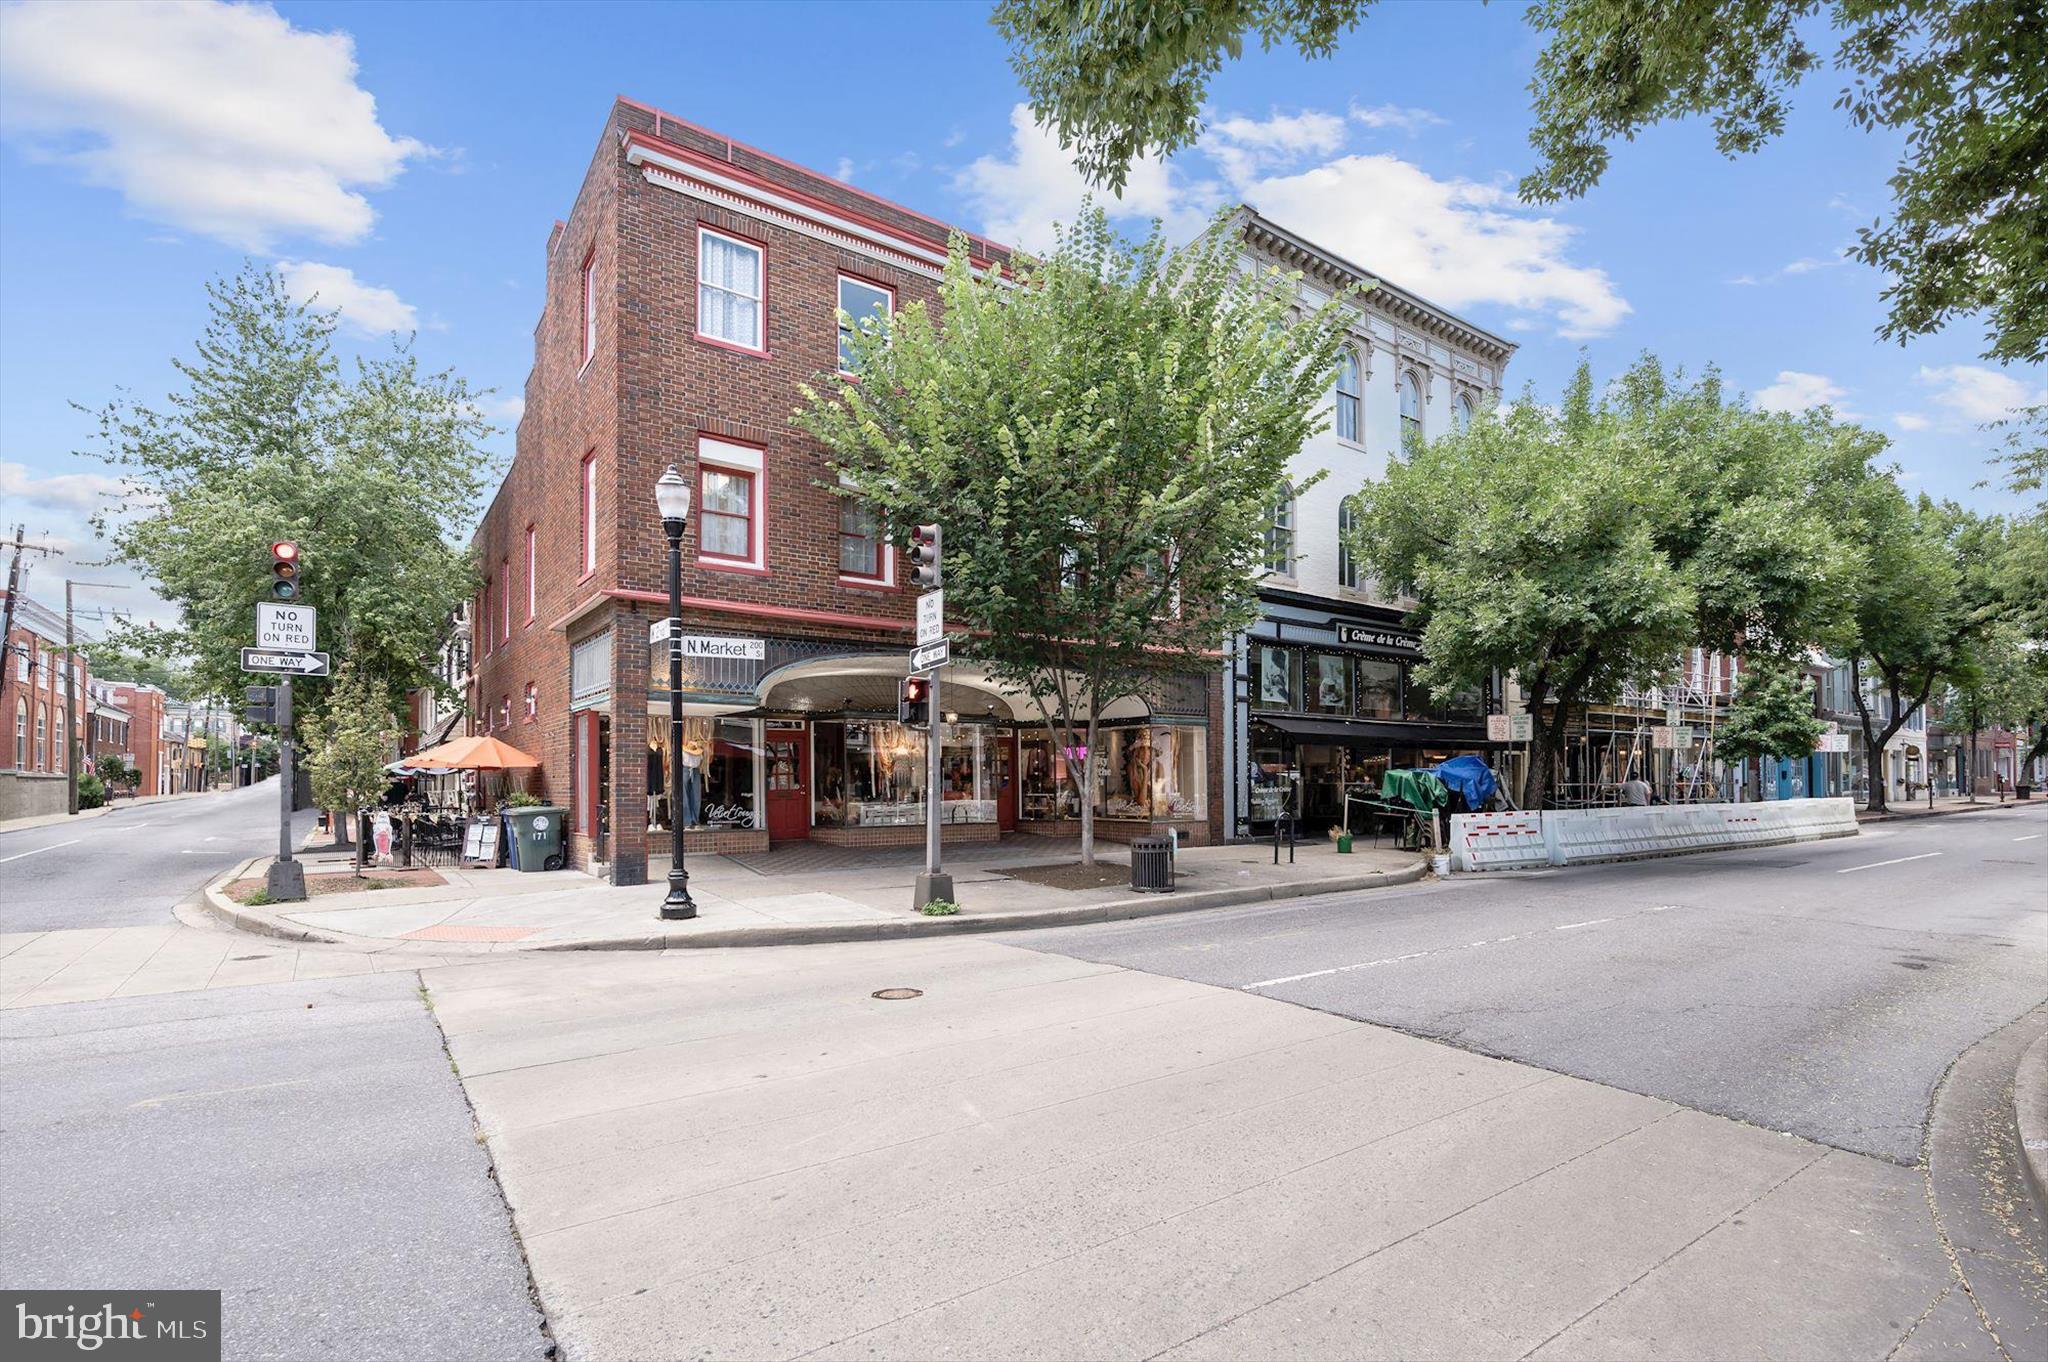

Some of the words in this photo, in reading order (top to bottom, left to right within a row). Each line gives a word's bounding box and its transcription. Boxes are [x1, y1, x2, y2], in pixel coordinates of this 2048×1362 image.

[275, 610, 298, 621] NO
[271, 622, 303, 632] TURN
[263, 632, 280, 642] ON
[286, 634, 309, 644] RED
[1351, 630, 1375, 643] Crème
[1376, 634, 1386, 644] de
[1386, 635, 1394, 645] la
[700, 640, 747, 656] Market
[749, 641, 764, 649] 200
[251, 655, 275, 665] ONE
[280, 657, 302, 667] WAY
